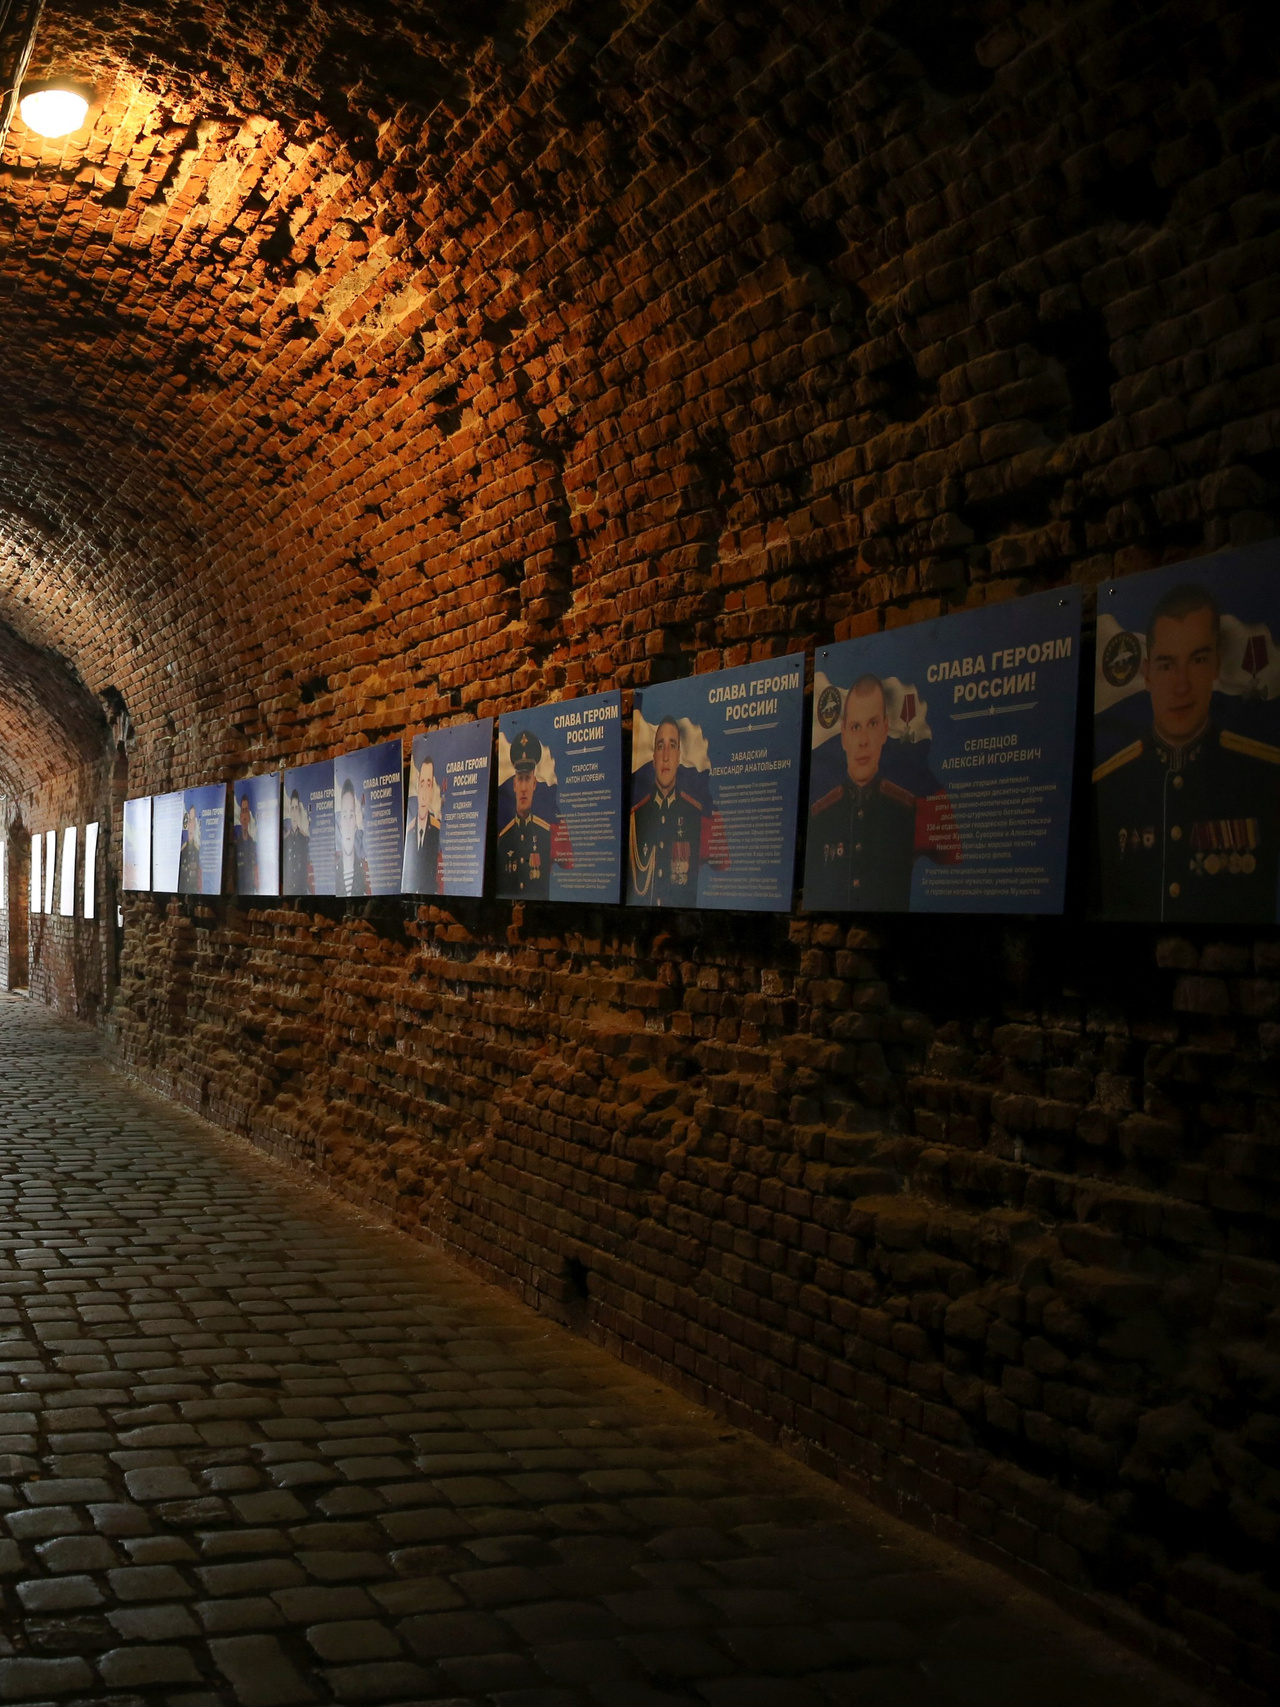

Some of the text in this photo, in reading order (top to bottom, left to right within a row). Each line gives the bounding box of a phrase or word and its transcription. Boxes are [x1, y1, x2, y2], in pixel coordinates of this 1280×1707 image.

[926, 654, 986, 683] СЛАВА
[991, 636, 1072, 671] ГЕРОЯМ
[708, 672, 800, 704] СЛАВА ГЕРОЯМ
[953, 671, 1037, 704] РОССИИ!
[554, 705, 619, 729] СЛАВА ГЕРОЯМ
[725, 698, 778, 722] РОССИИ!
[566, 726, 604, 745] РОССИИ!
[964, 734, 1018, 752] СЕЛЕДЦОВ
[730, 747, 768, 762] ЗАВАДСКИЙ
[941, 748, 1042, 770] АЛЕКСЕЙ ИГОРЕВИЧ
[446, 756, 488, 774] СЛАВА ГЕРОЯМ
[572, 763, 599, 773] СТАРОСТИН
[708, 759, 791, 777] АЛЕКСАНДР АНАТОЛЬЕВИЧ
[453, 773, 478, 787] РОССИИ!
